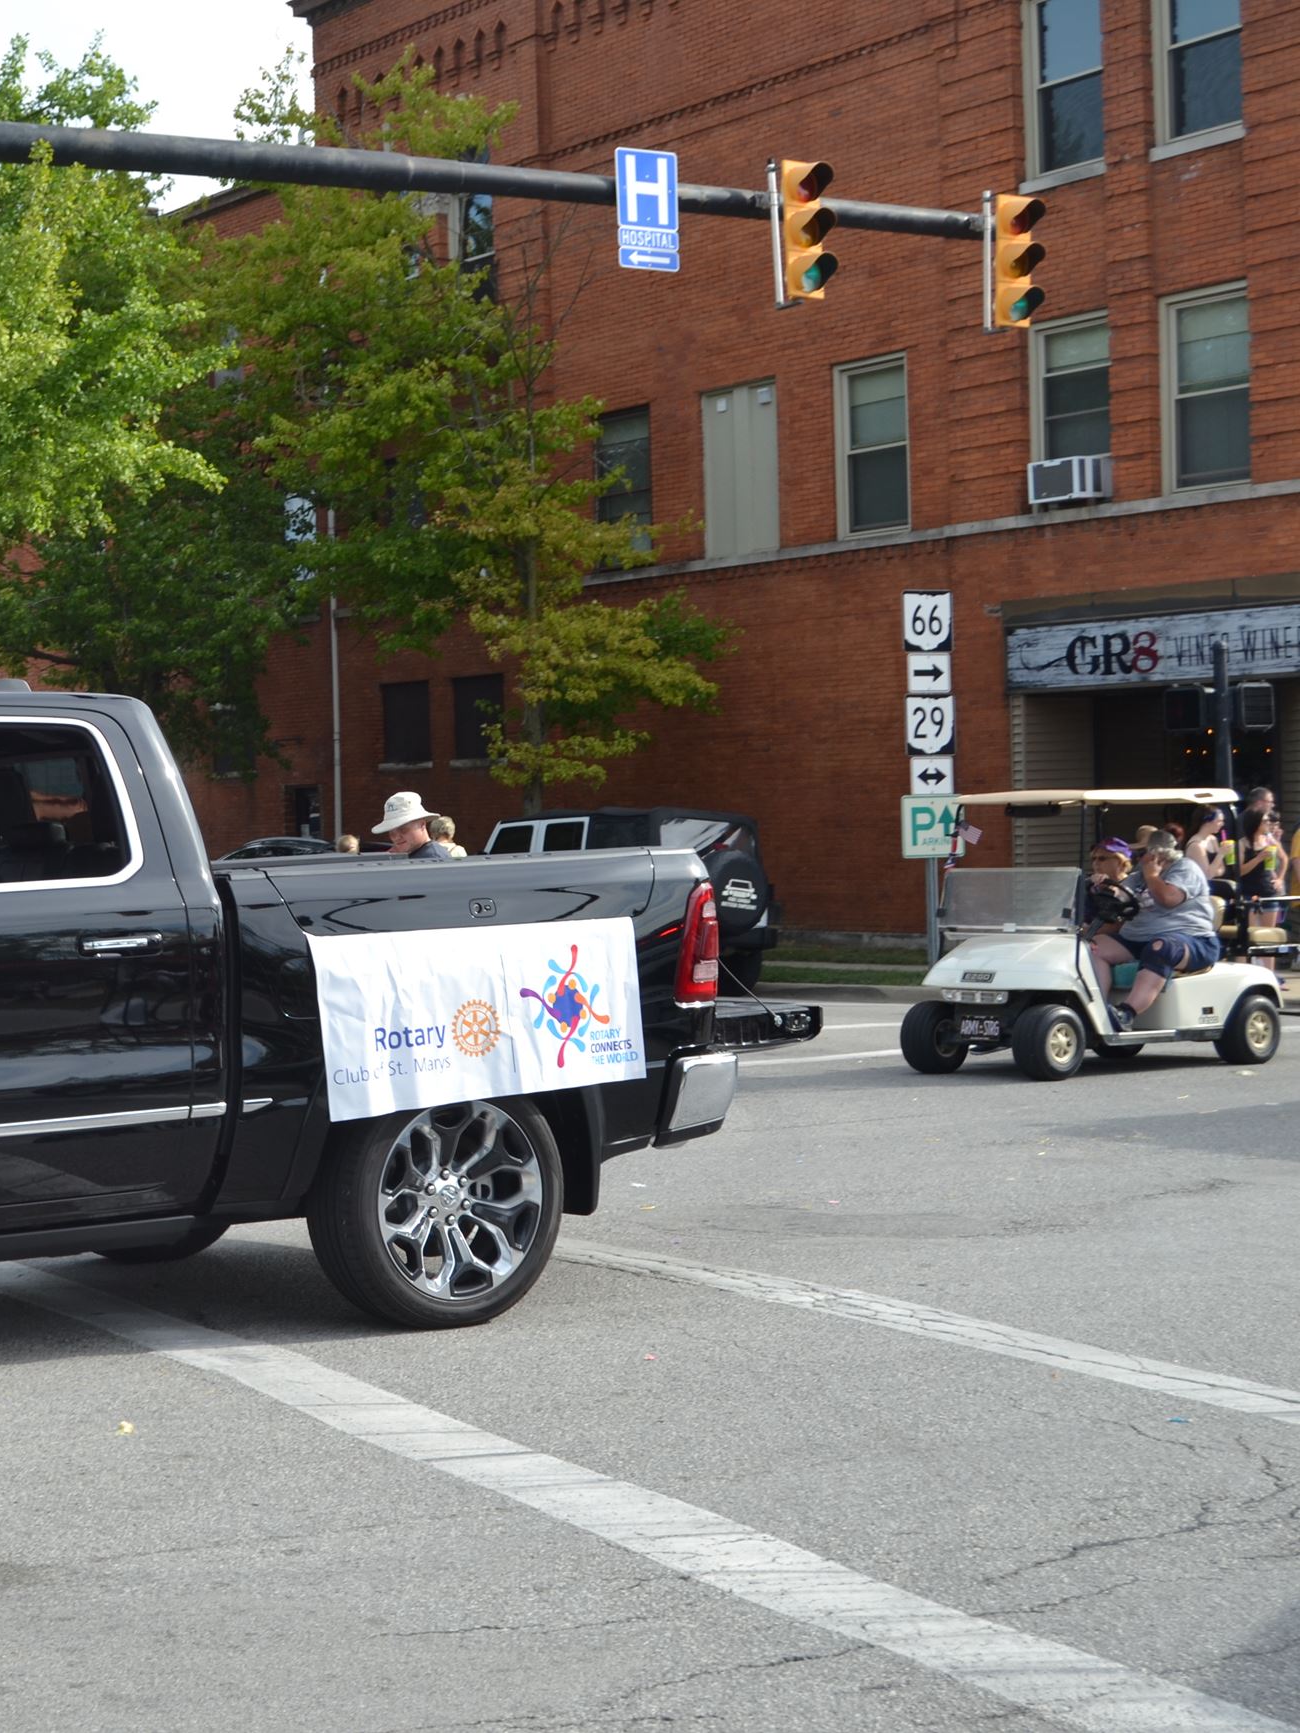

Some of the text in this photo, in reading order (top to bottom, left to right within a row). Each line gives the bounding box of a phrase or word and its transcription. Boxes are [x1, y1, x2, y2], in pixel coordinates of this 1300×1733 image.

[625, 154, 669, 225] H
[622, 230, 675, 248] HOSPITAL
[912, 604, 942, 636] 66
[1065, 631, 1159, 676] GR8
[1240, 626, 1300, 661] WINE
[913, 706, 944, 739] 29
[375, 1025, 445, 1052] Rotary
[590, 1027, 620, 1040] ROTARY
[591, 1039, 632, 1053] CONNECTS
[606, 1051, 638, 1063] WORLD
[333, 1066, 369, 1085] Club
[388, 1060, 408, 1076] St.
[414, 1057, 451, 1073] Marys
